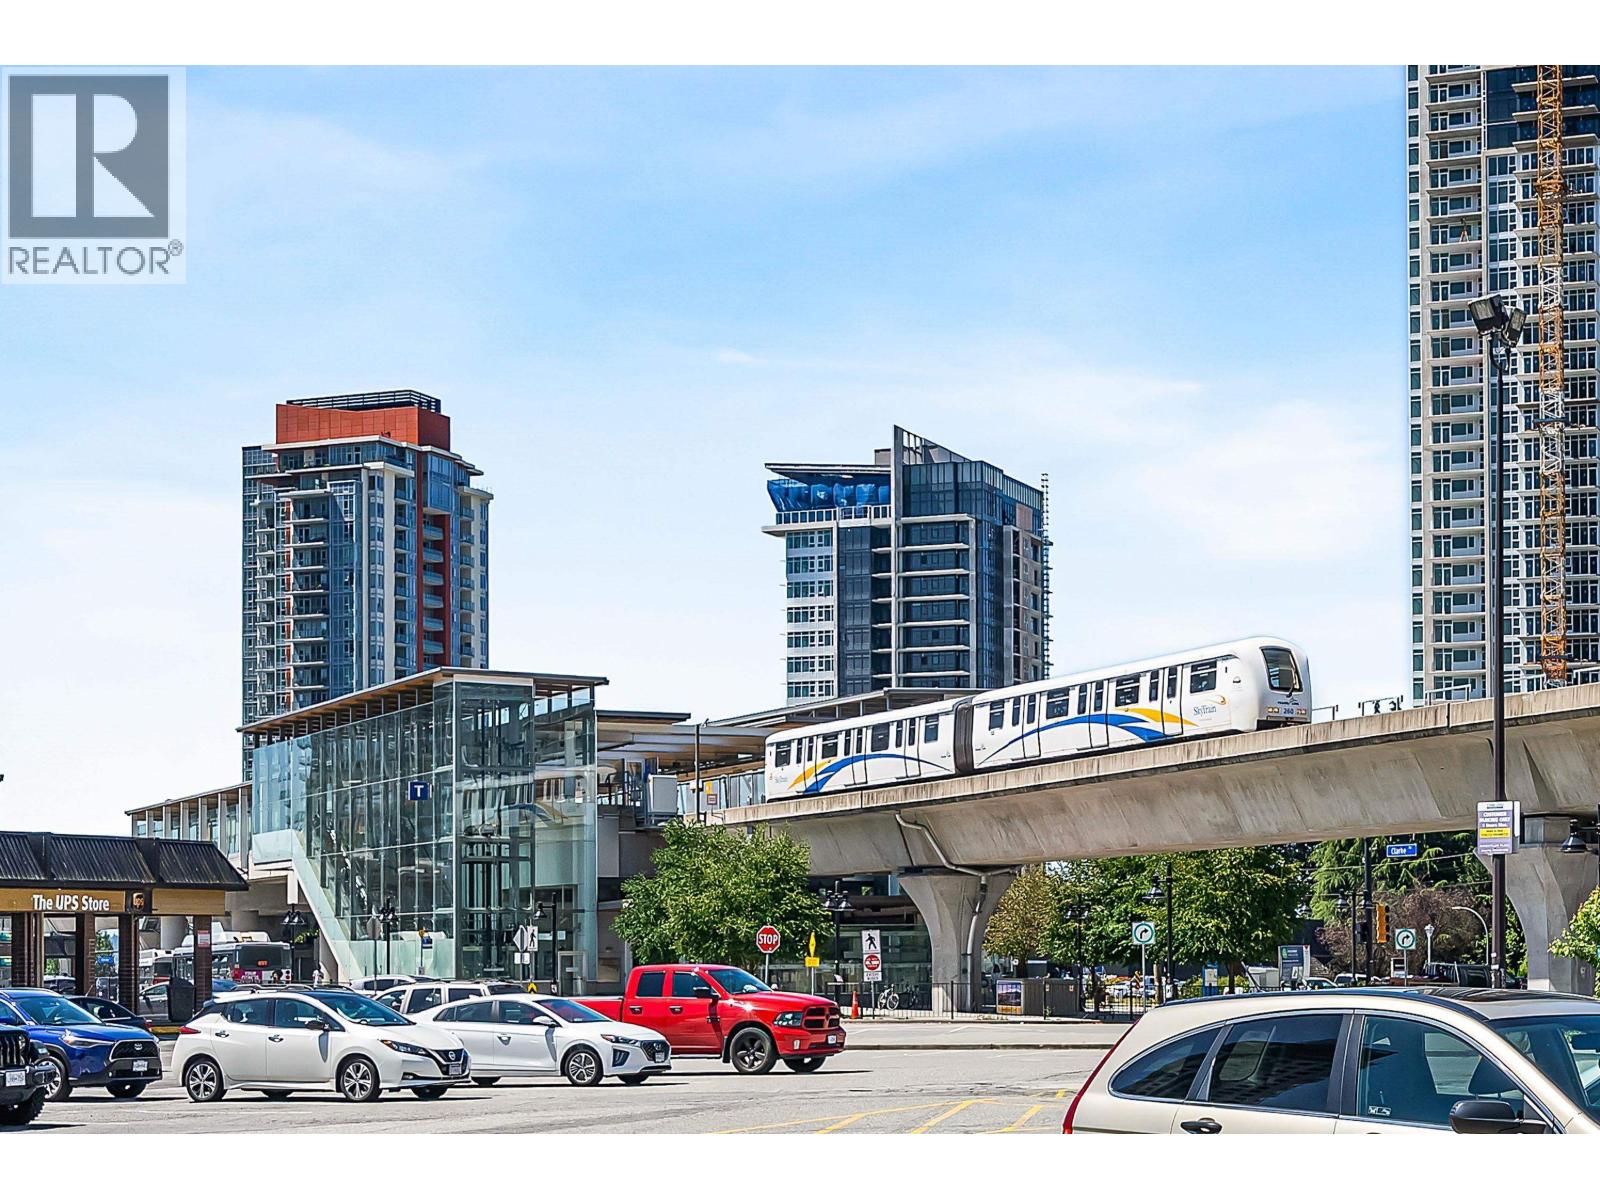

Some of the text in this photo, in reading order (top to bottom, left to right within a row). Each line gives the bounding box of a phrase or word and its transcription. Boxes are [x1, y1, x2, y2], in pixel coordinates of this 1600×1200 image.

[1193, 704, 1216, 717] SkyTrain
[414, 785, 424, 797] T
[1391, 847, 1406, 855] Clarke
[32, 894, 110, 911] The UPS Store
[758, 933, 778, 945] STOP
